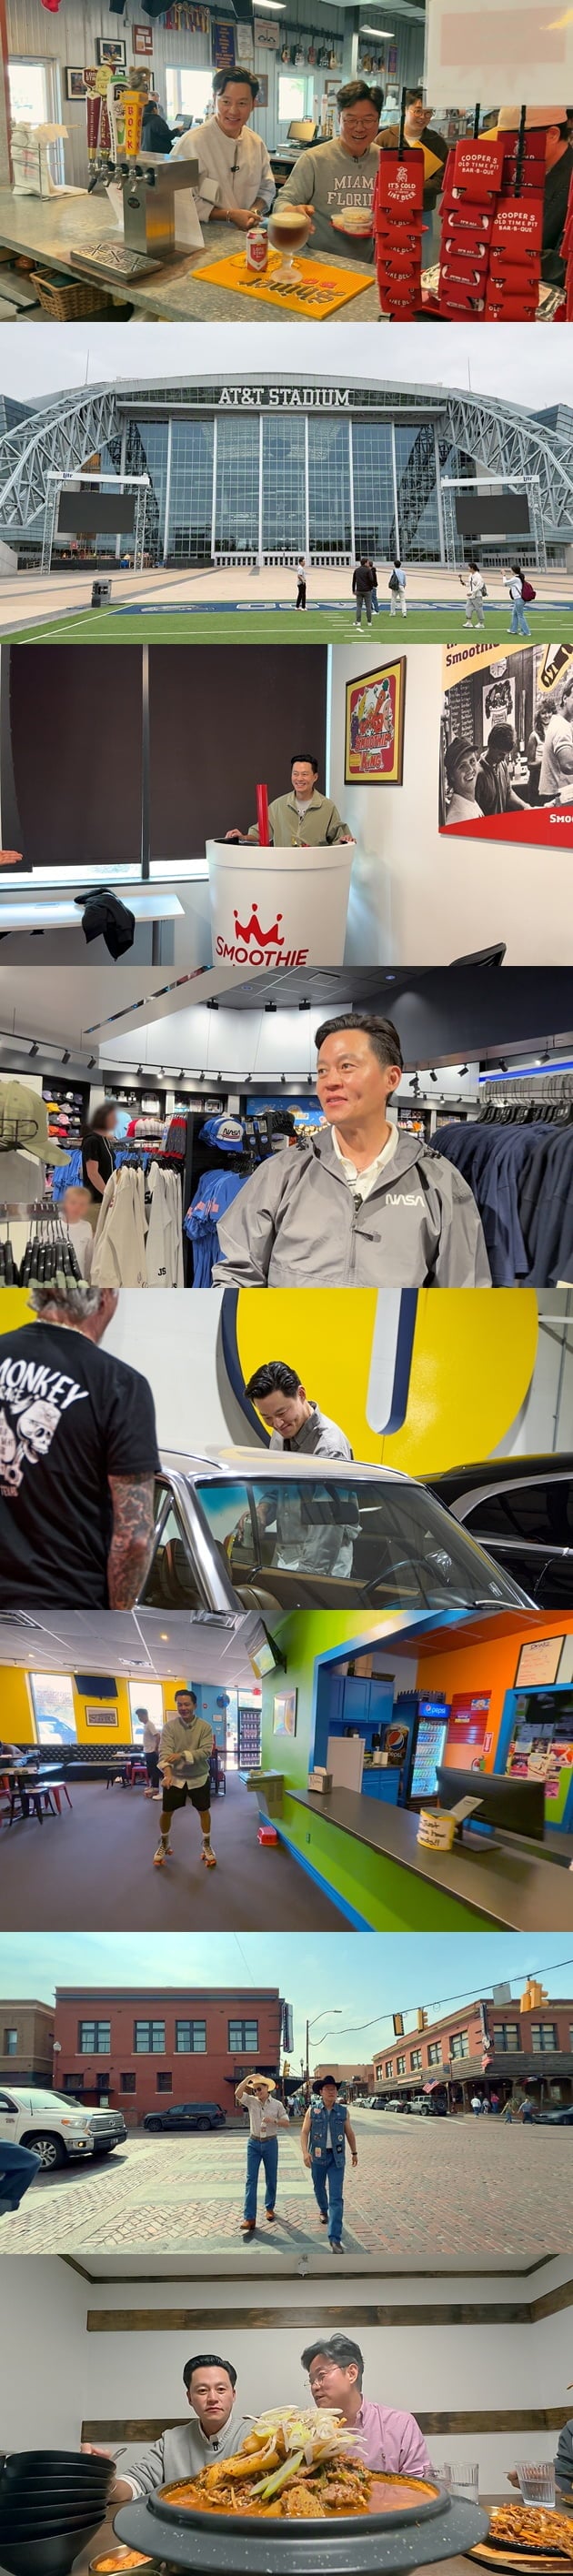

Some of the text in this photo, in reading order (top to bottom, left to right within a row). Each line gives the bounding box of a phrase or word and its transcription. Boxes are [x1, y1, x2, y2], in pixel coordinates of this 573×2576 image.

[334, 175, 374, 191] MIAM
[218, 387, 350, 406] AT&T STADIUM
[550, 814, 573, 823] SMO
[216, 936, 309, 966] SMOOTHIE
[223, 1127, 241, 1136] NASA
[385, 1193, 425, 1208] NASA
